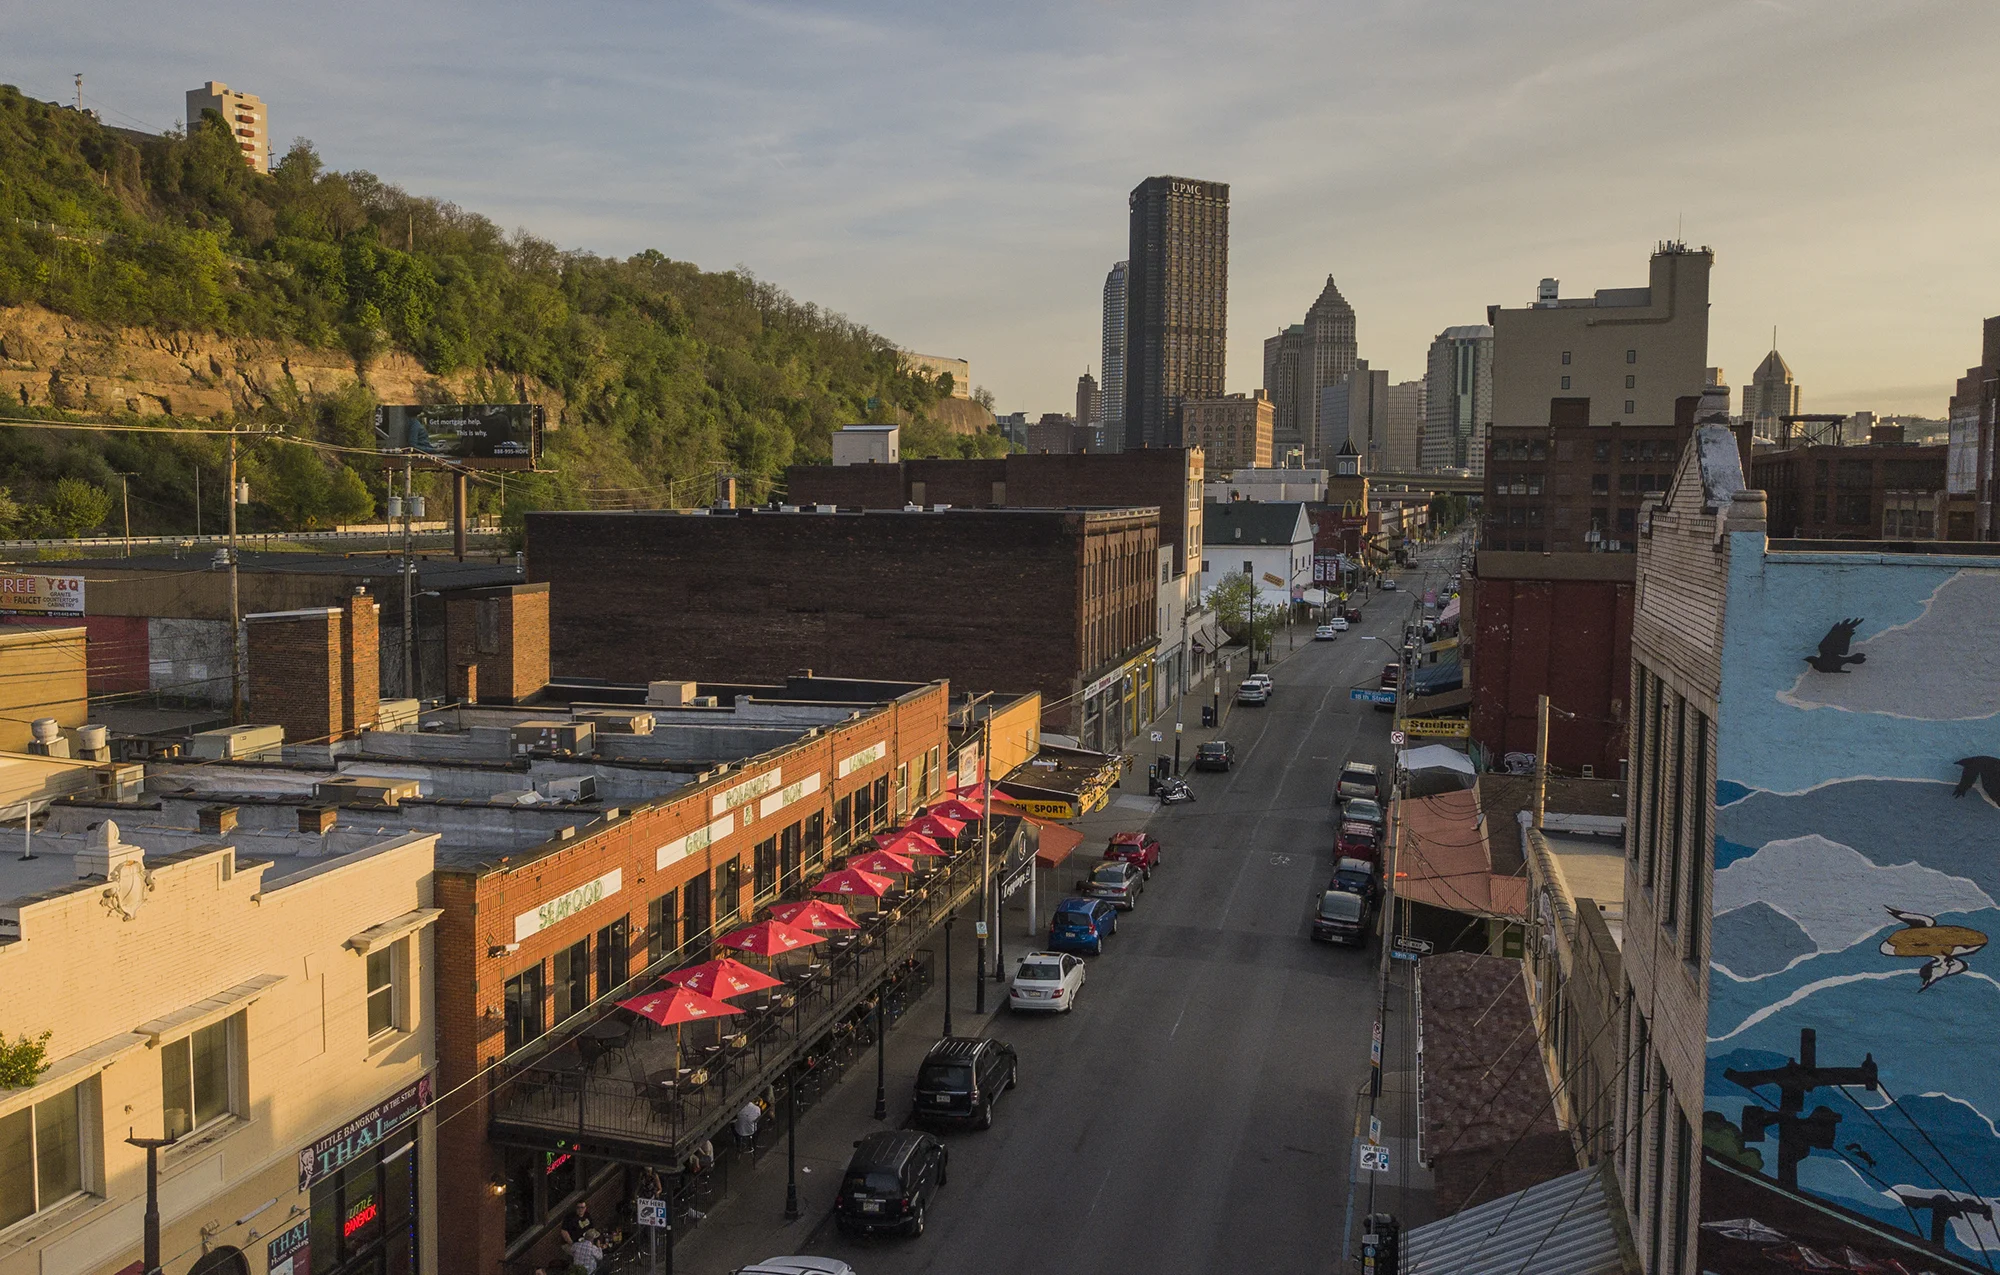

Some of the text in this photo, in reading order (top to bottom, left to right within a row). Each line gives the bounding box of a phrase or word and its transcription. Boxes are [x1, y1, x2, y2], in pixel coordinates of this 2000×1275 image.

[1172, 182, 1202, 195] UPMC
[429, 418, 482, 427] Get mortgage help.
[474, 430, 488, 438] why.
[14, 596, 41, 605] FAUCET
[1410, 720, 1465, 729] Steelers
[1034, 804, 1067, 814] SPORT!
[539, 879, 604, 929] SEAFOOD
[316, 1087, 417, 1154] LITTLE BANGKOK IN THE STRIP
[317, 1117, 384, 1175] THAI
[349, 1194, 373, 1219] LITTLE
[344, 1204, 377, 1238] BANGKOK
[269, 1220, 309, 1257] THAI
